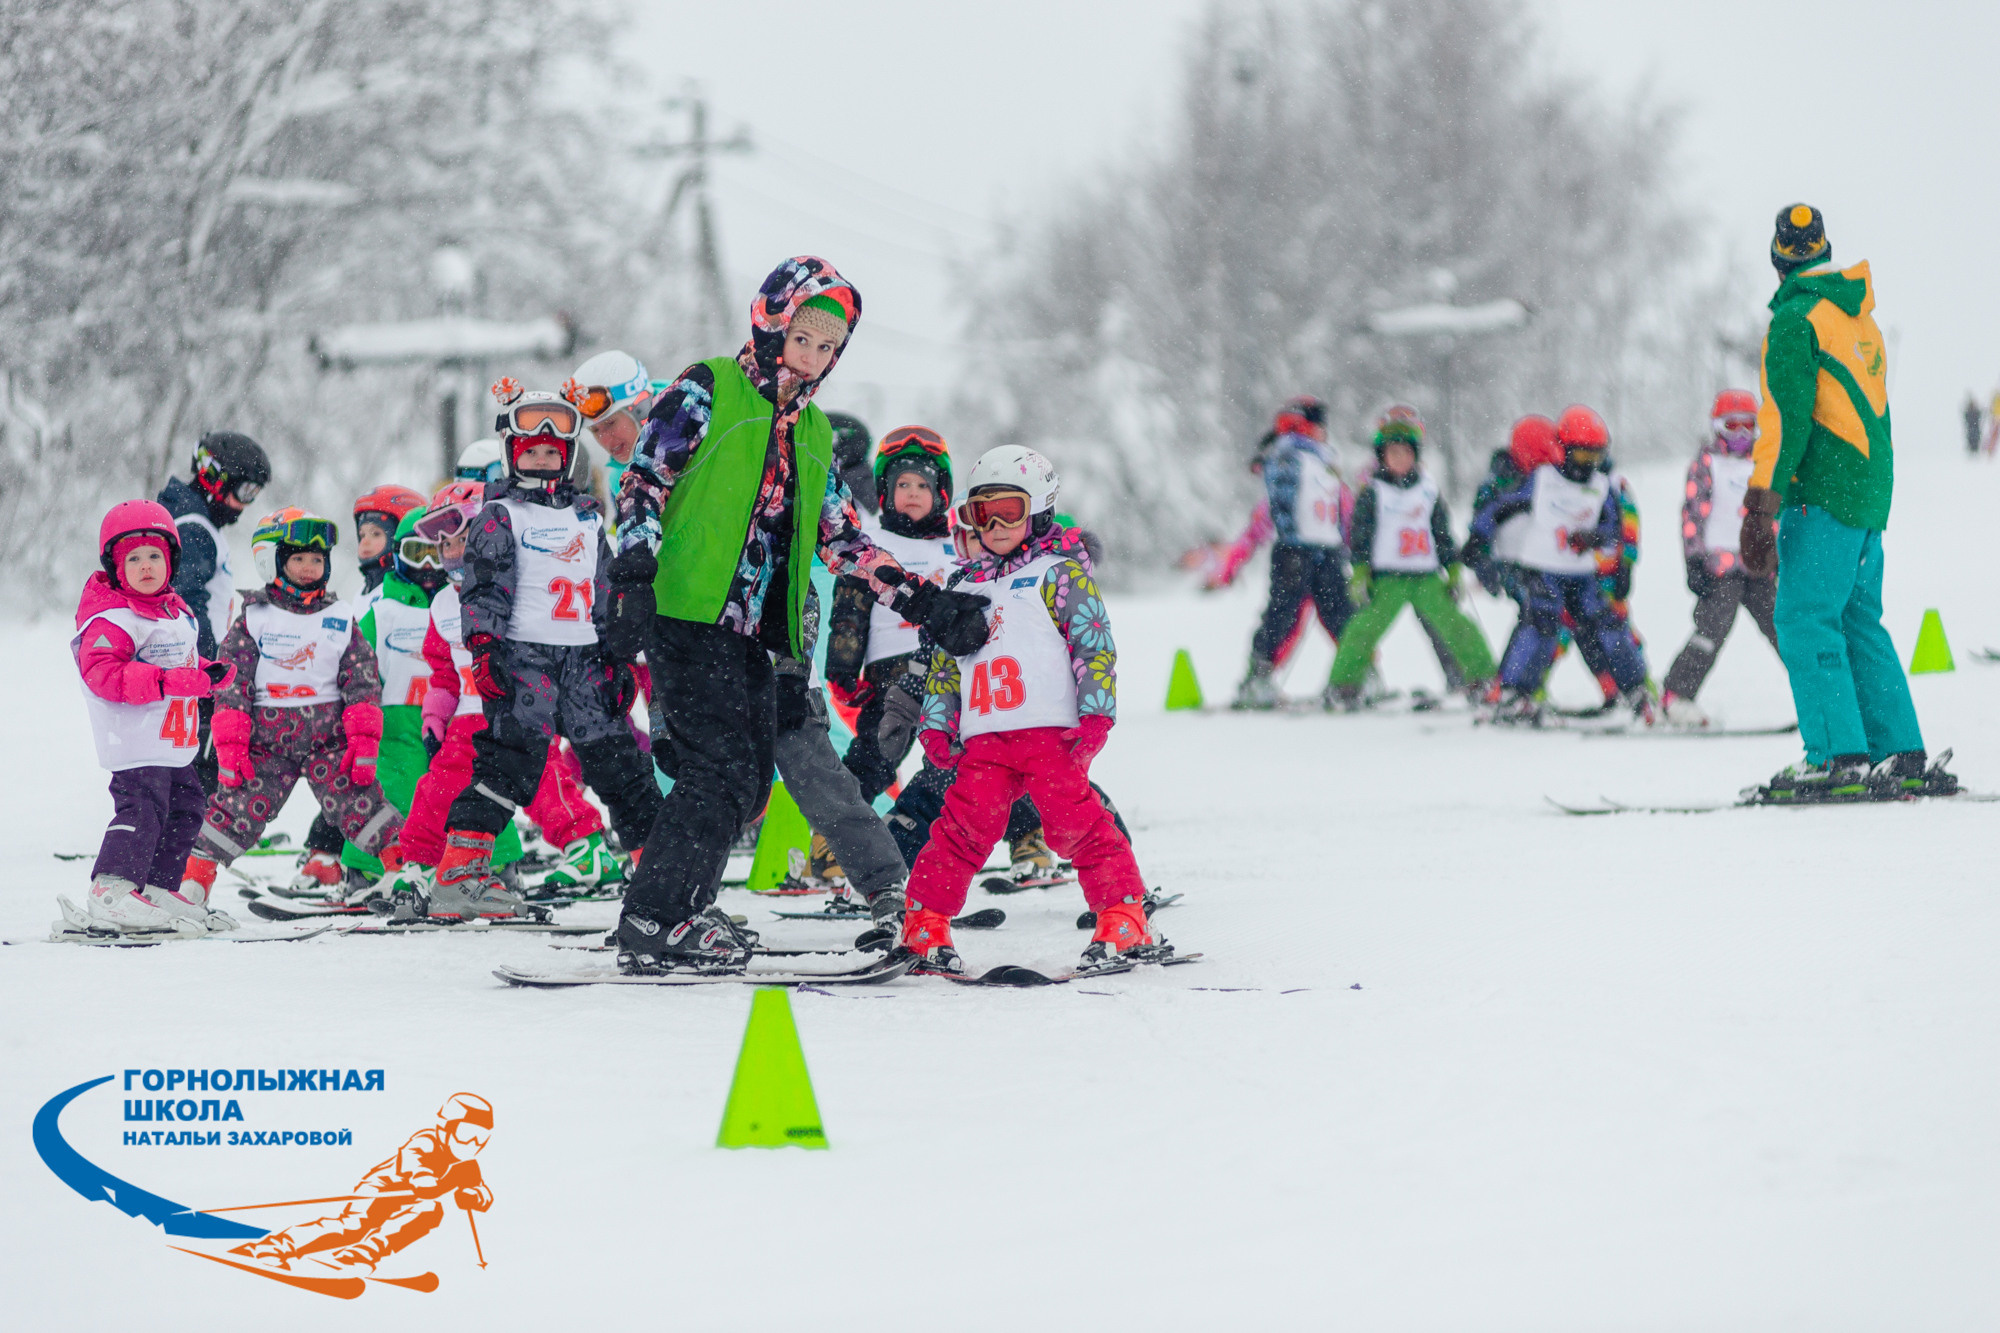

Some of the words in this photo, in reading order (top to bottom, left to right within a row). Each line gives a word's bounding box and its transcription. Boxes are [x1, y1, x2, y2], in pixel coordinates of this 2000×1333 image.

[548, 576, 592, 622] 21
[969, 655, 1027, 717] 43
[159, 696, 199, 749] 42
